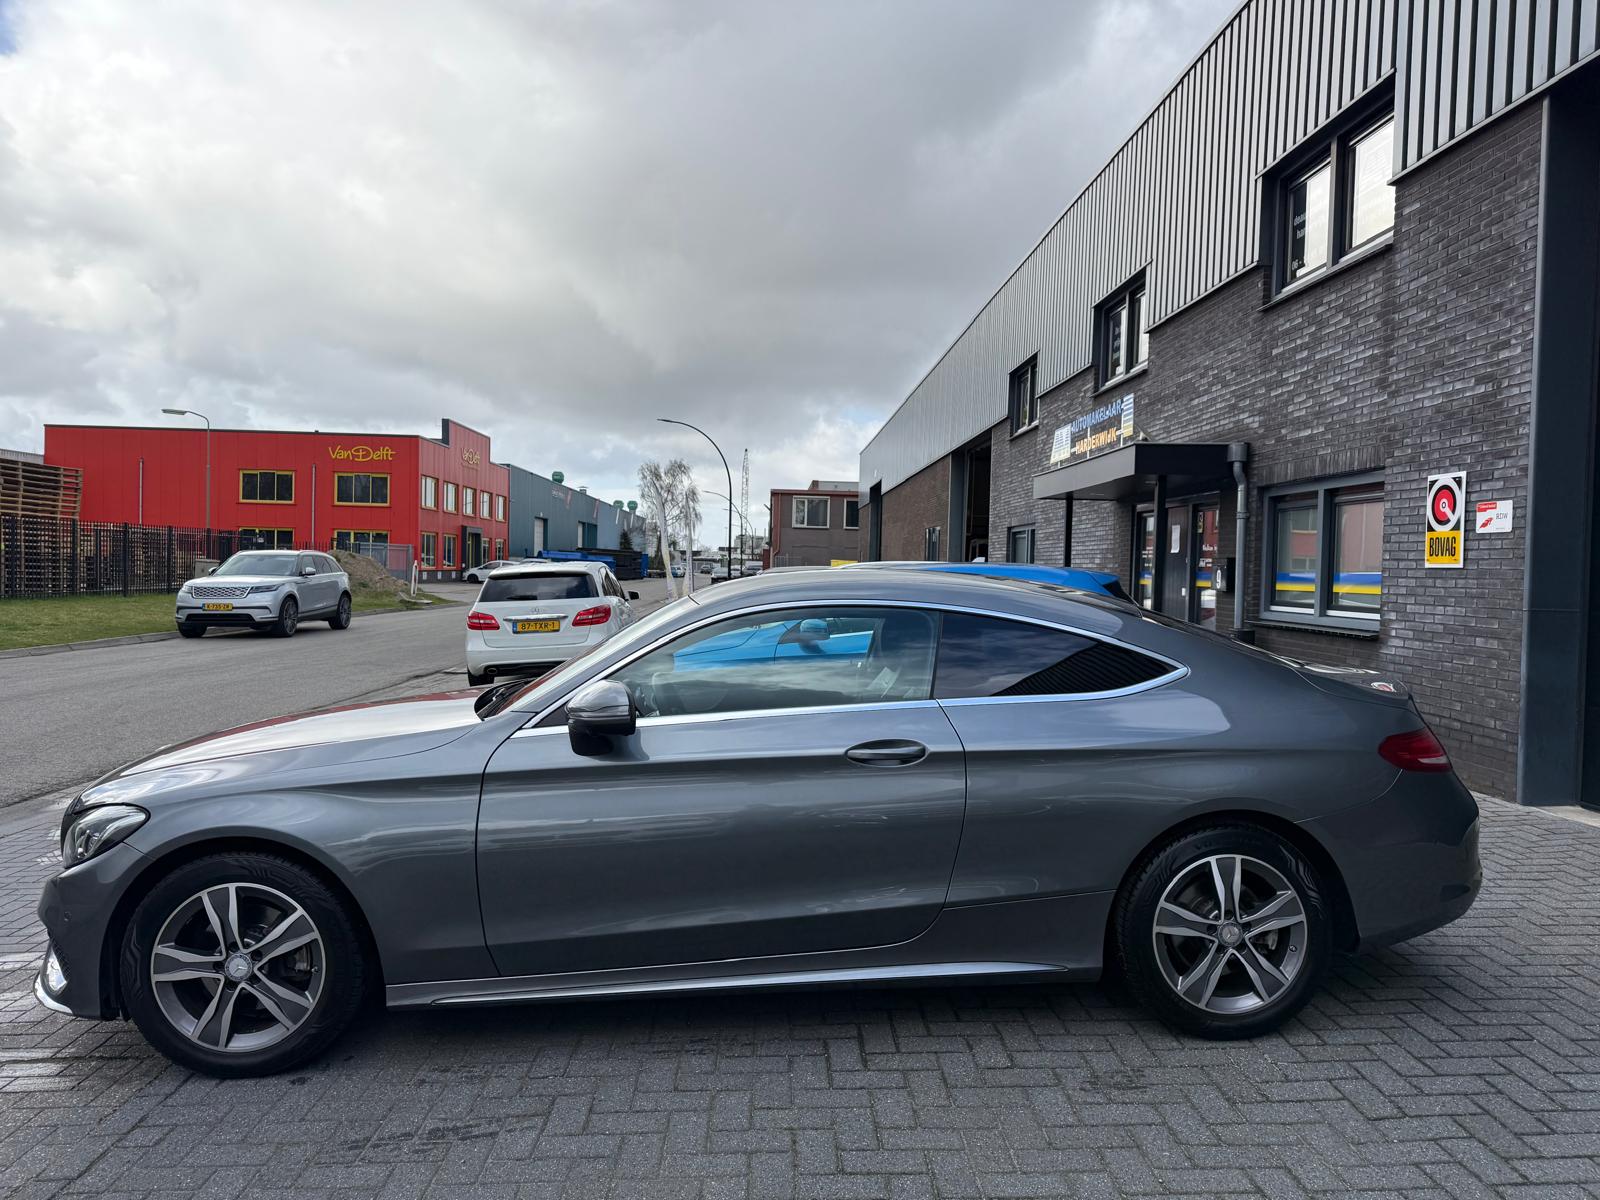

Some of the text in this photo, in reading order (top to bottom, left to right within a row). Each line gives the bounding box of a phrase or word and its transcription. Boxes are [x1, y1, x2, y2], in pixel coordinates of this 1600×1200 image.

[1071, 399, 1121, 433] AUTOMAKELAAR
[1075, 427, 1117, 454] HARDERWIJK
[1429, 536, 1456, 557] BOVAG
[1216, 569, 1222, 589] 9
[520, 621, 556, 630] 87-TXR-1
